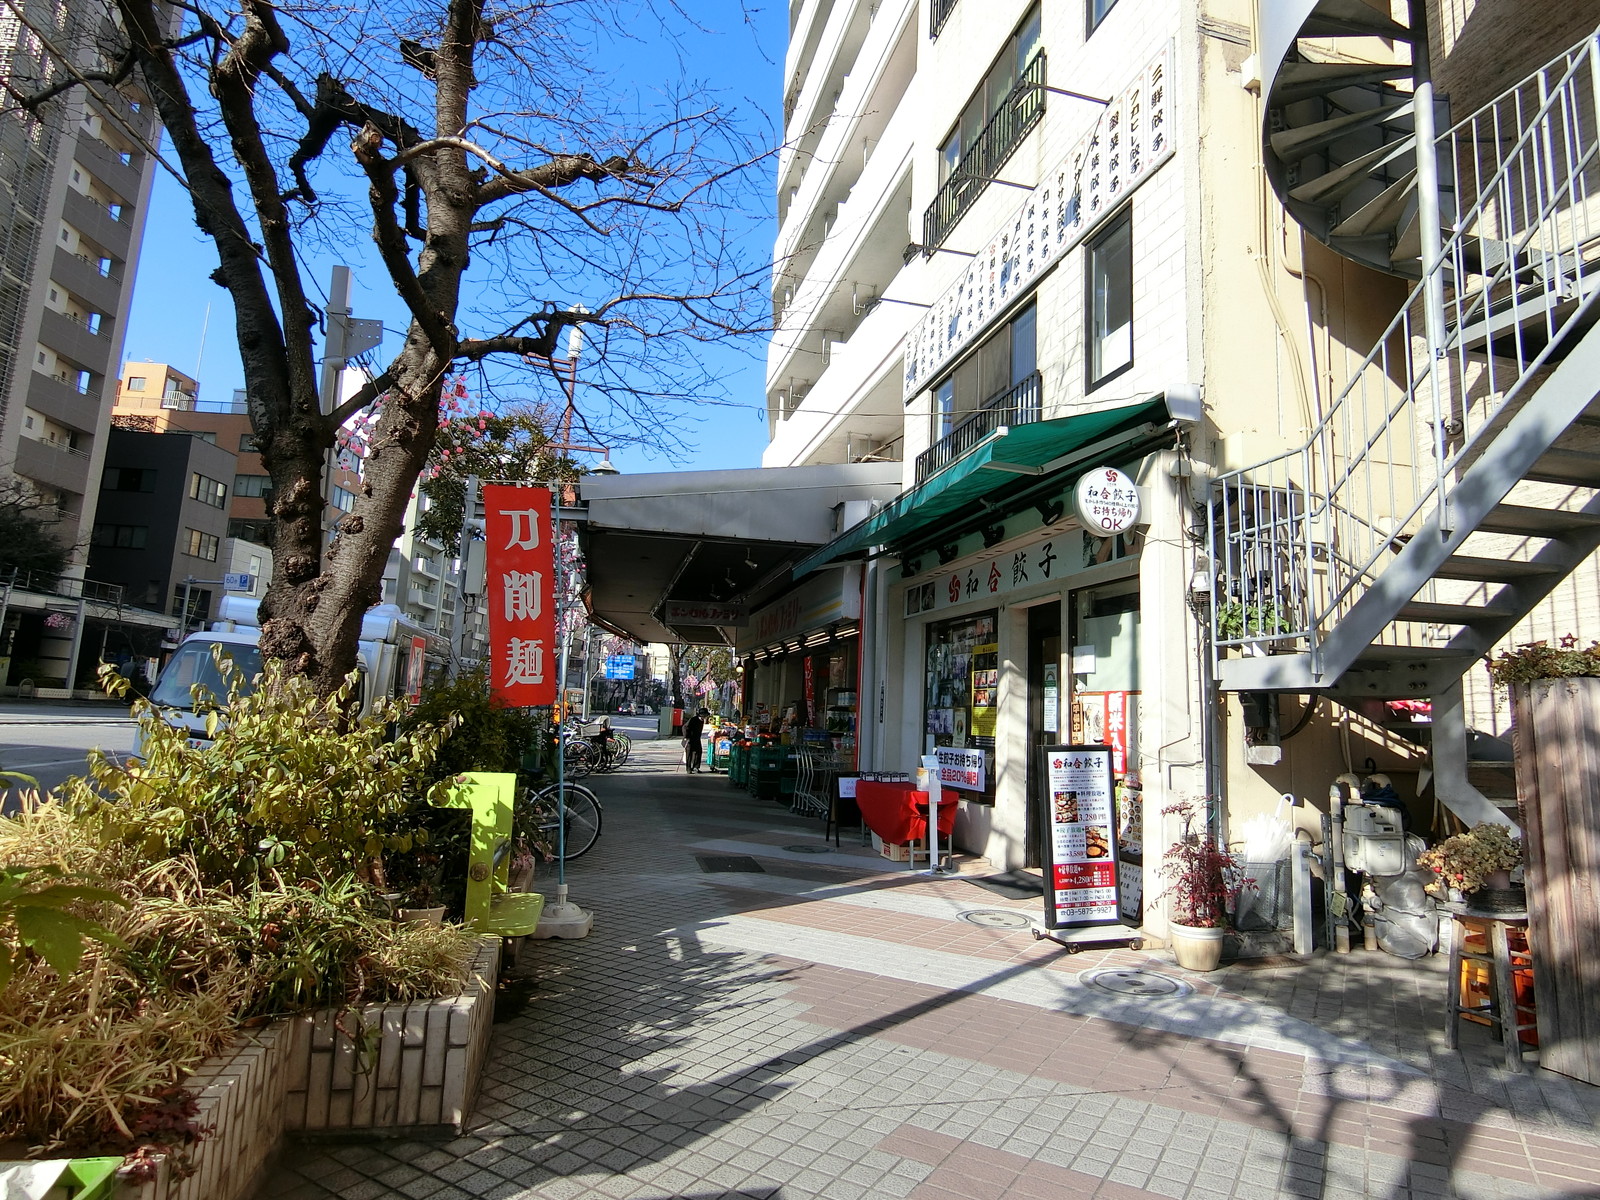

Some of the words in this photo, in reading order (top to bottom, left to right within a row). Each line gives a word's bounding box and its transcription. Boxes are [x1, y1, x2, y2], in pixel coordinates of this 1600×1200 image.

[1130, 89, 1140, 174] フカヒレ餃子
[1088, 486, 1136, 502] 和合餃子
[1093, 505, 1132, 518] お持ち帰り
[1101, 518, 1123, 530] OK
[965, 541, 1058, 598] 和合餃子
[498, 507, 544, 688] 刀削麺
[938, 751, 983, 768] 生餃子お持ち帰り
[1063, 757, 1104, 769] 和合餃子
[941, 768, 979, 786] 全品20%割引
[1066, 906, 1112, 916] 03-5875-9927
